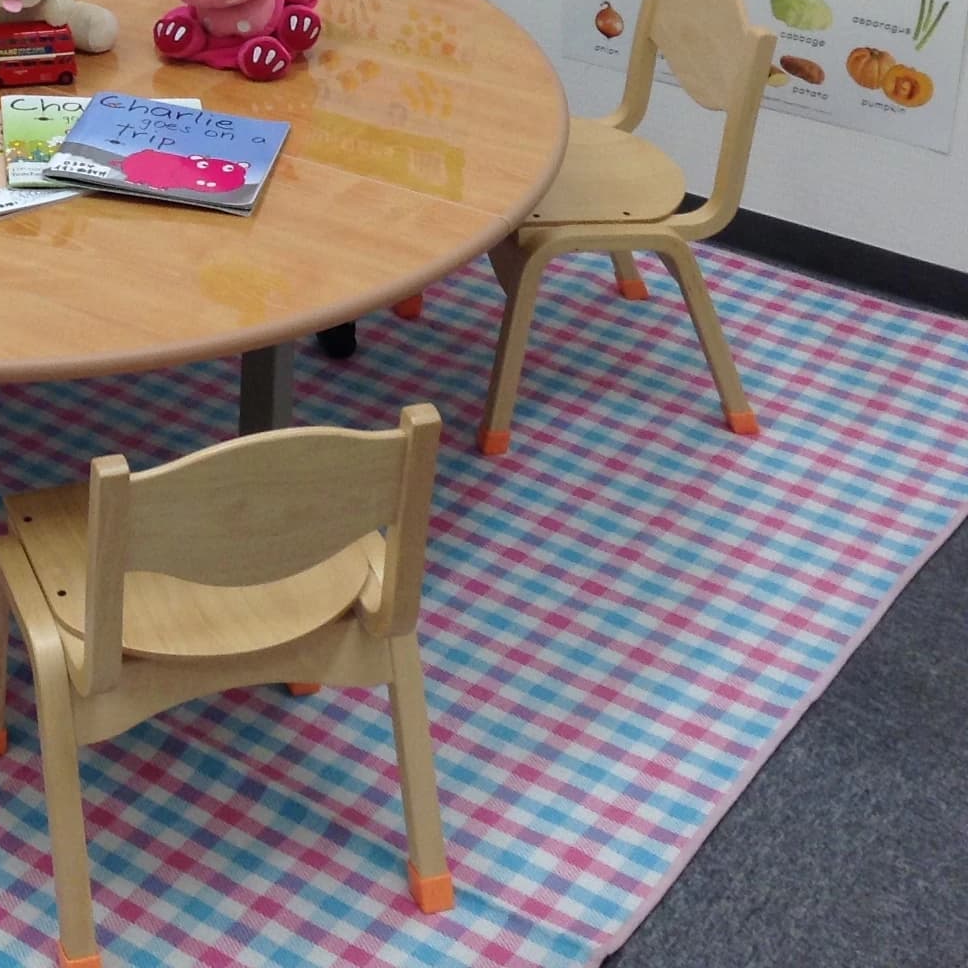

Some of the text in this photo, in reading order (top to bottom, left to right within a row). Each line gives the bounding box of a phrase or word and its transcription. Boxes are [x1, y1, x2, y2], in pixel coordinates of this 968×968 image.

[780, 31, 826, 47] cabbage
[852, 16, 912, 35] asparagus
[100, 95, 234, 131] Charlie
[116, 122, 176, 149] trip
[141, 118, 266, 145] goes on a
